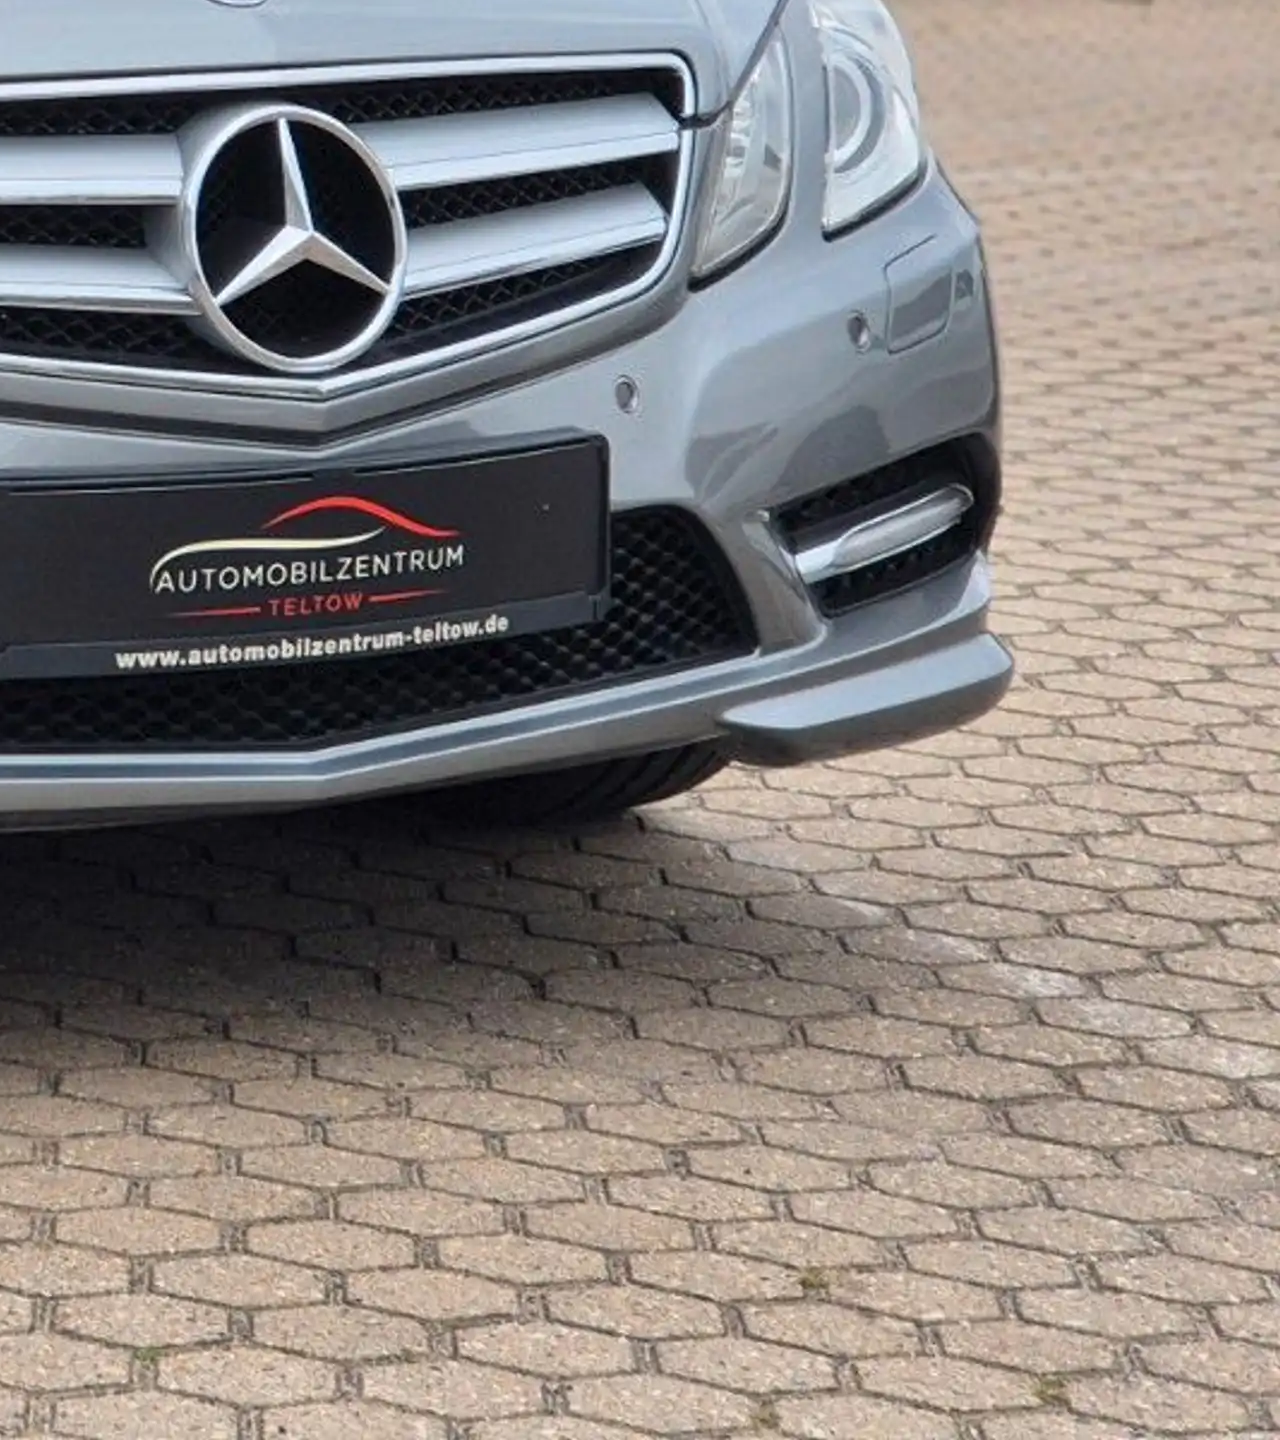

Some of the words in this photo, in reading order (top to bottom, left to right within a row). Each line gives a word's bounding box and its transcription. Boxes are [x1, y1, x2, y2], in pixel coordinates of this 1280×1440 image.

[152, 544, 465, 594] AUTOMOBILZENTRUM
[269, 592, 364, 617] TELTOW
[114, 612, 510, 670] www.automobilzentrum-teltow.de
